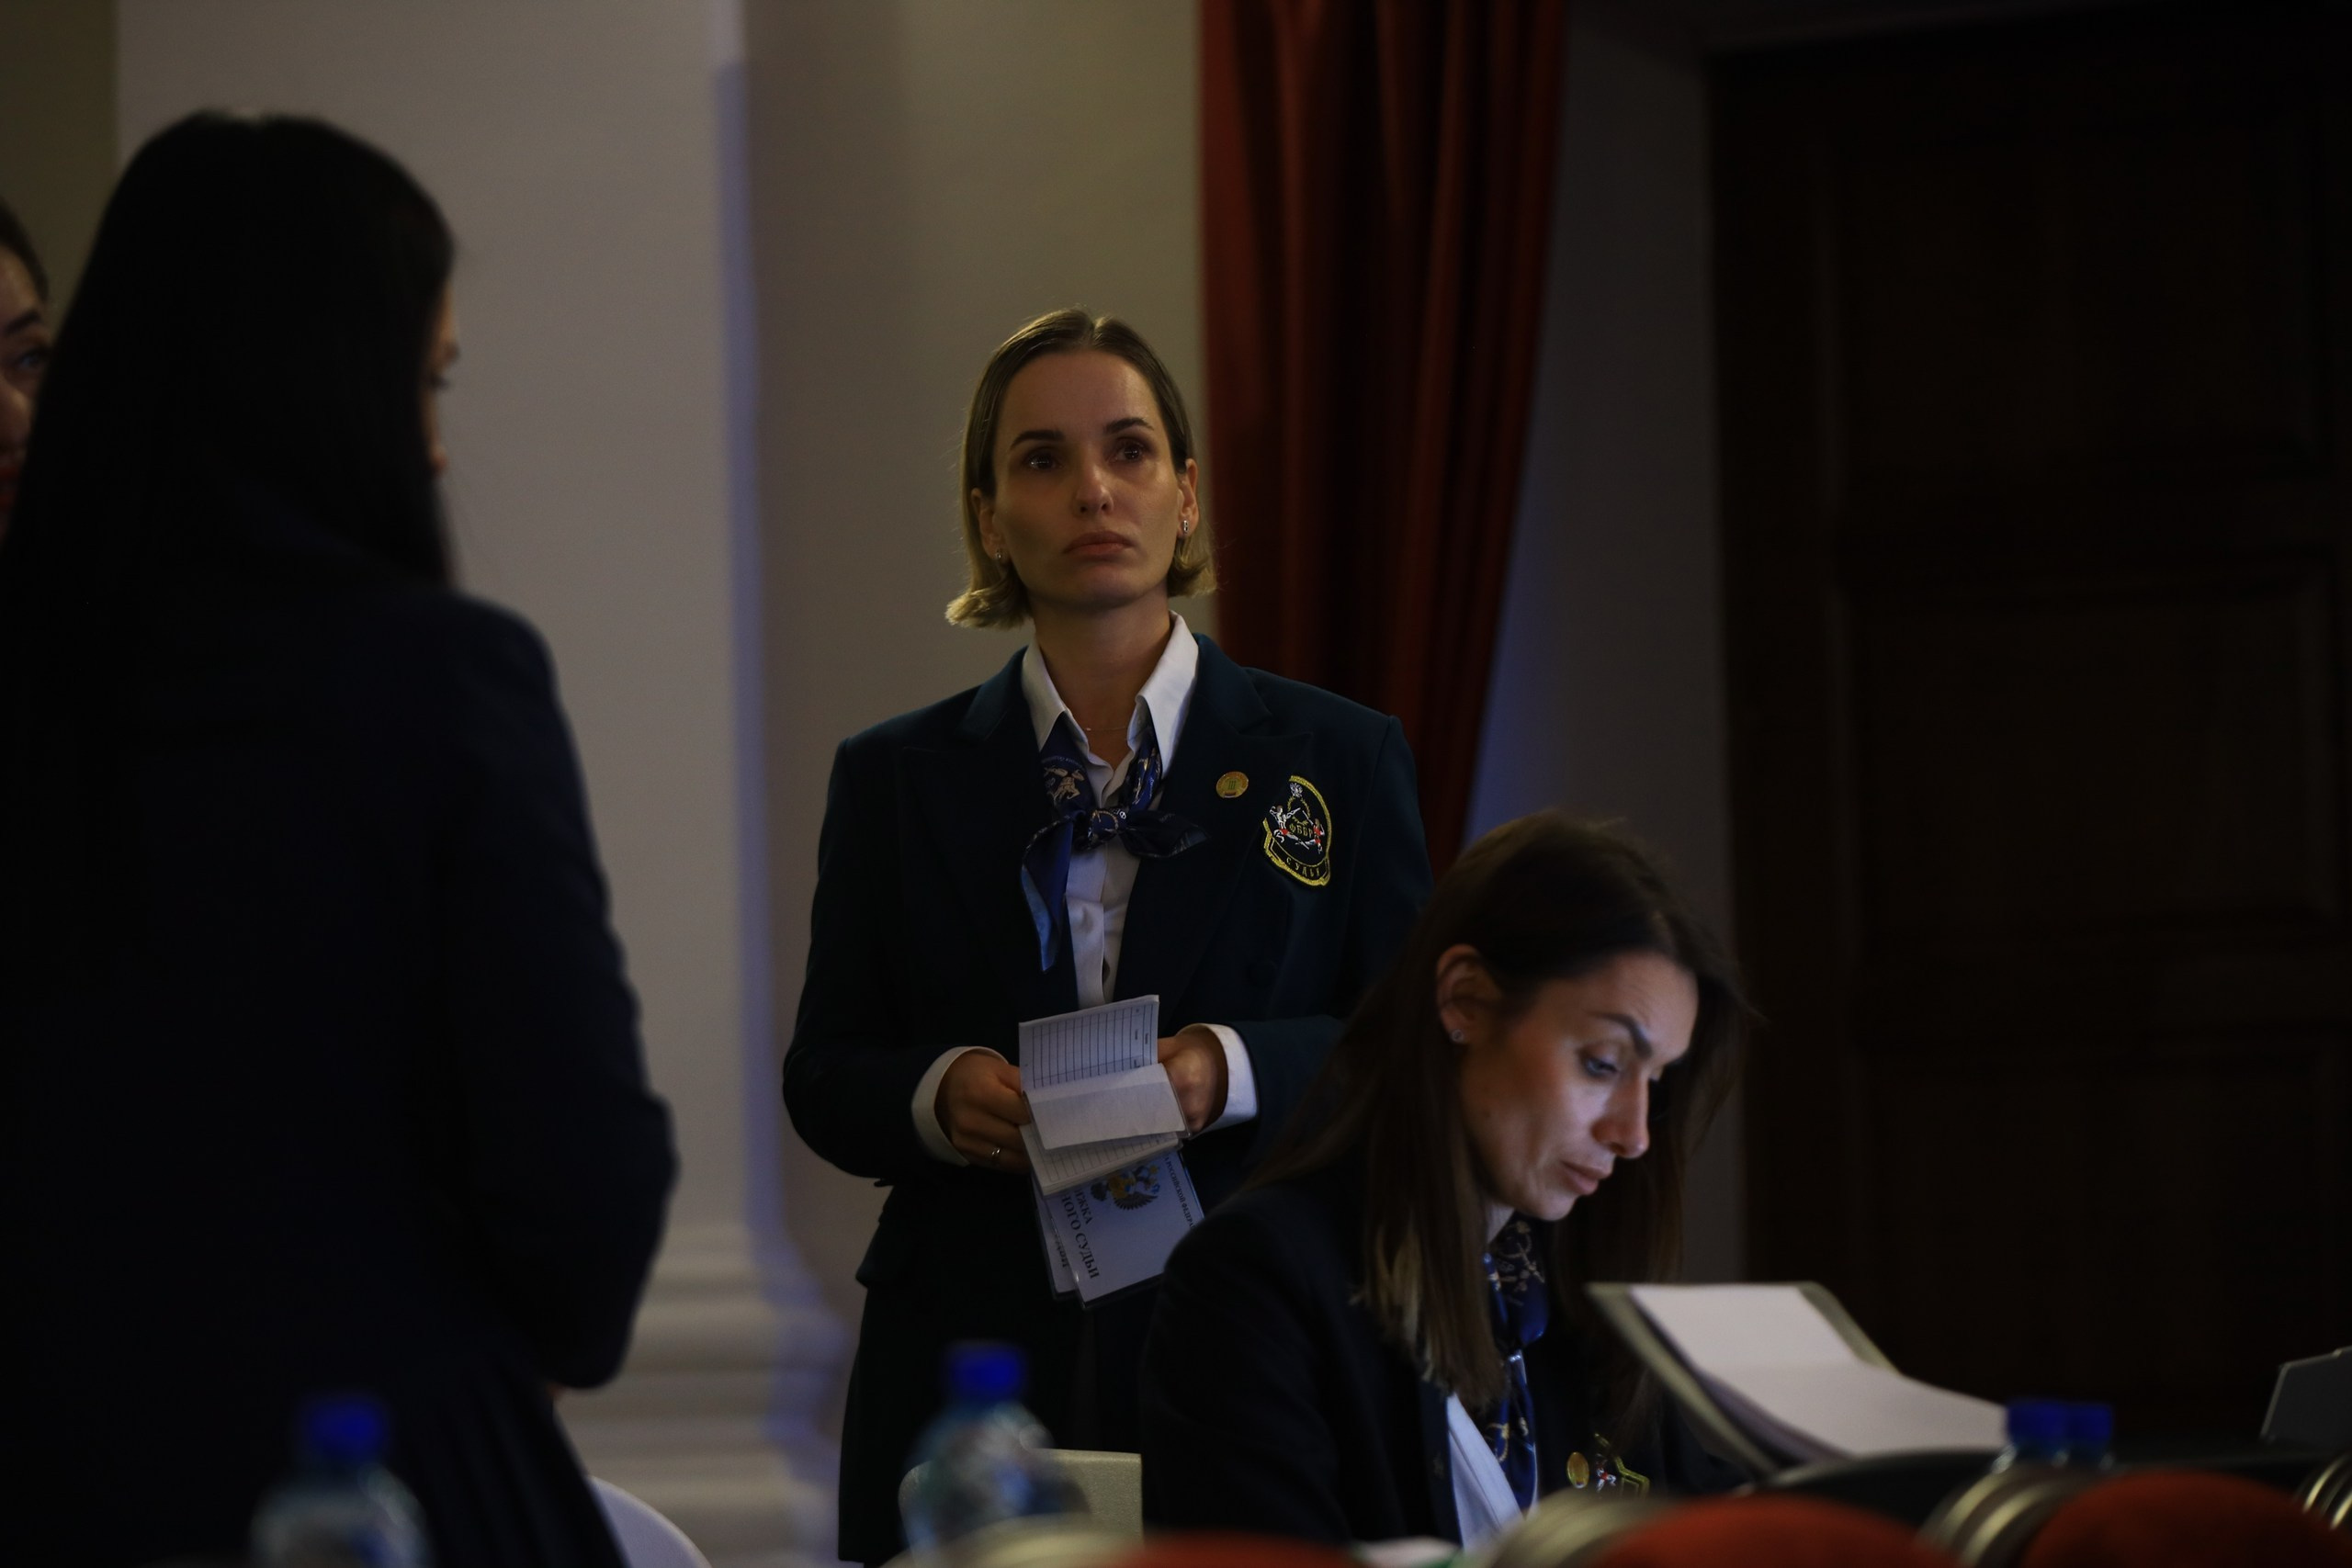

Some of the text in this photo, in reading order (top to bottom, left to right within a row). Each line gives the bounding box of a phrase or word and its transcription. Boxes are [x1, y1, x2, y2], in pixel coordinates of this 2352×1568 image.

[1074, 1189, 1094, 1224] ИЖКА
[1165, 1160, 1186, 1202] РОССИЙСКОЙ
[1182, 1202, 1196, 1228] ФЕДЕРА
[1061, 1194, 1082, 1231] НОГО
[1075, 1233, 1100, 1278] СУДЬИ
